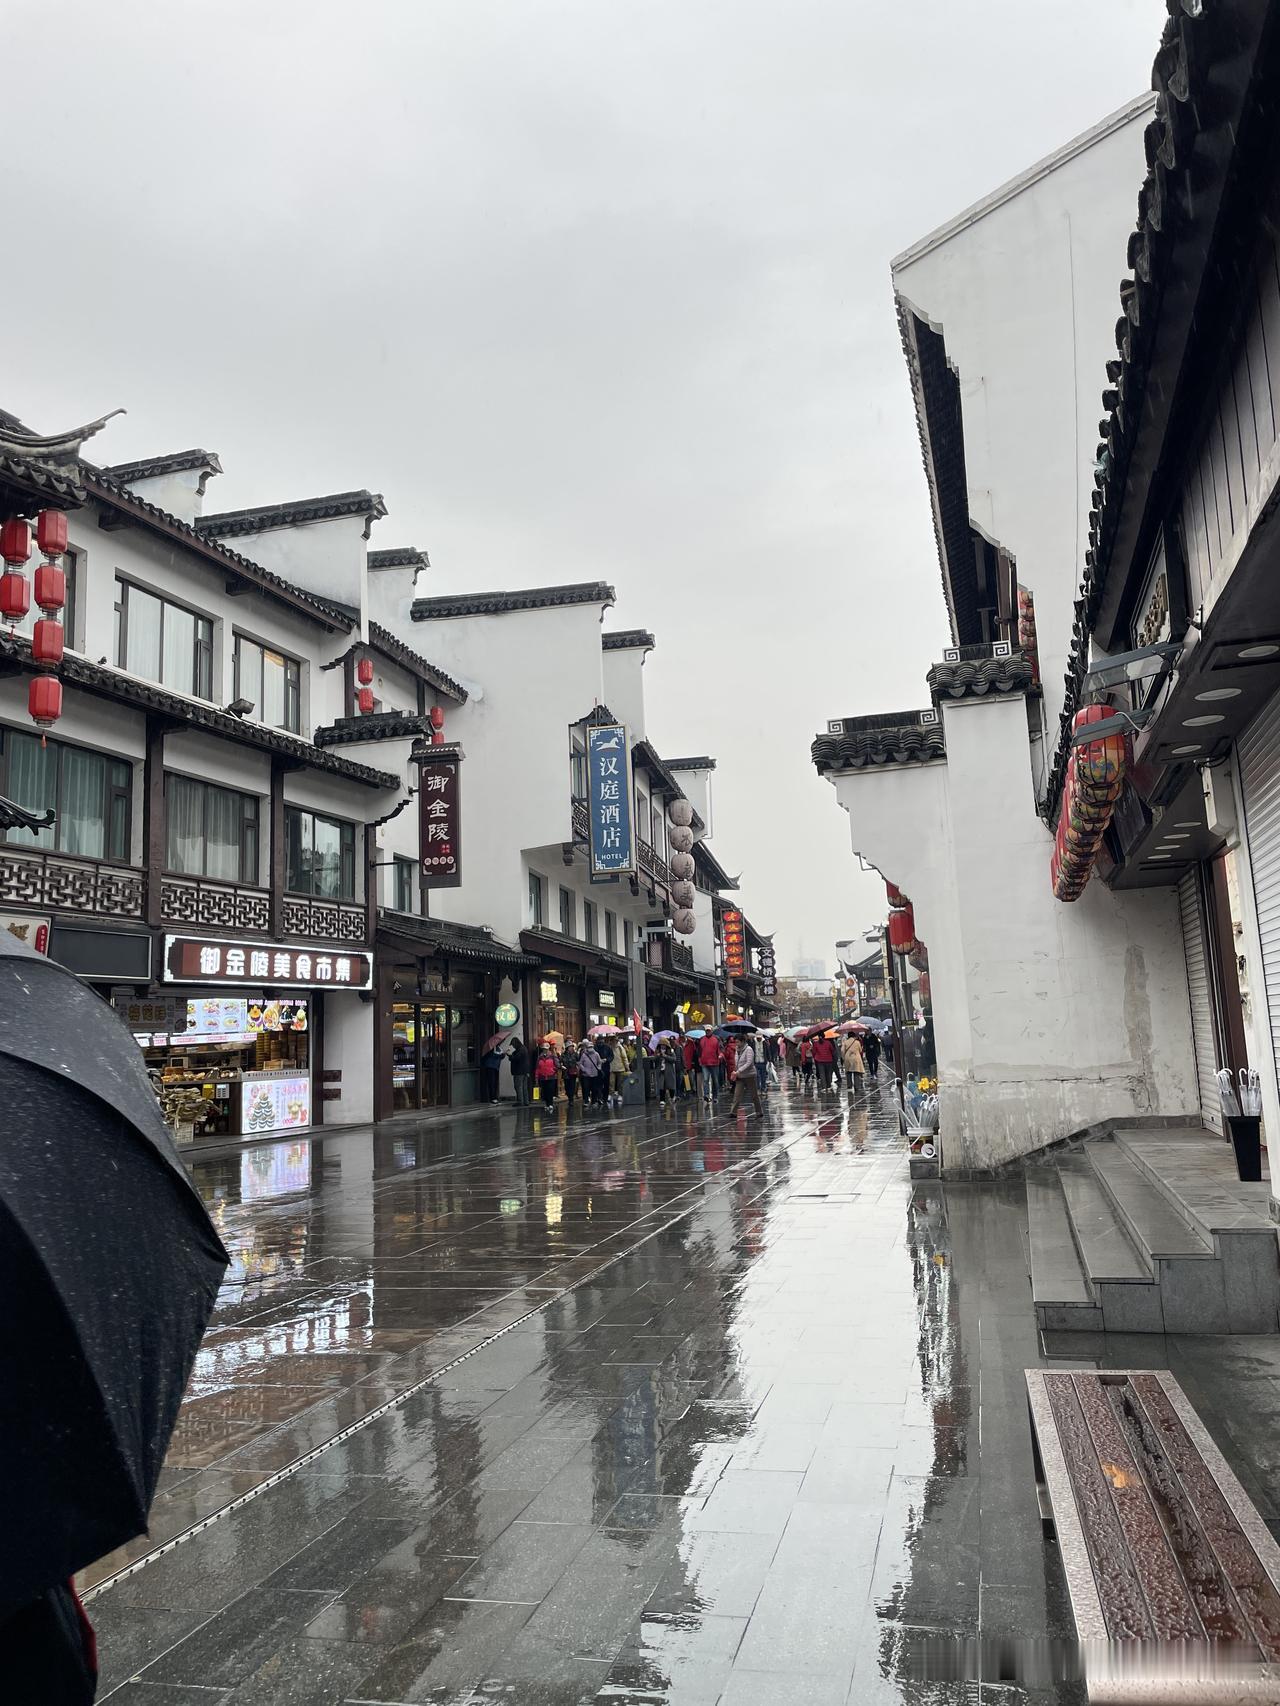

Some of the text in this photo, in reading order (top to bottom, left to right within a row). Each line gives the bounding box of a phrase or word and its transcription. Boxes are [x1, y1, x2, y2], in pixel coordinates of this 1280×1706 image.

[427, 776, 450, 842] 御金陵
[600, 757, 620, 848] 汉庭酒店
[200, 946, 351, 982] 御金陵美食市集
